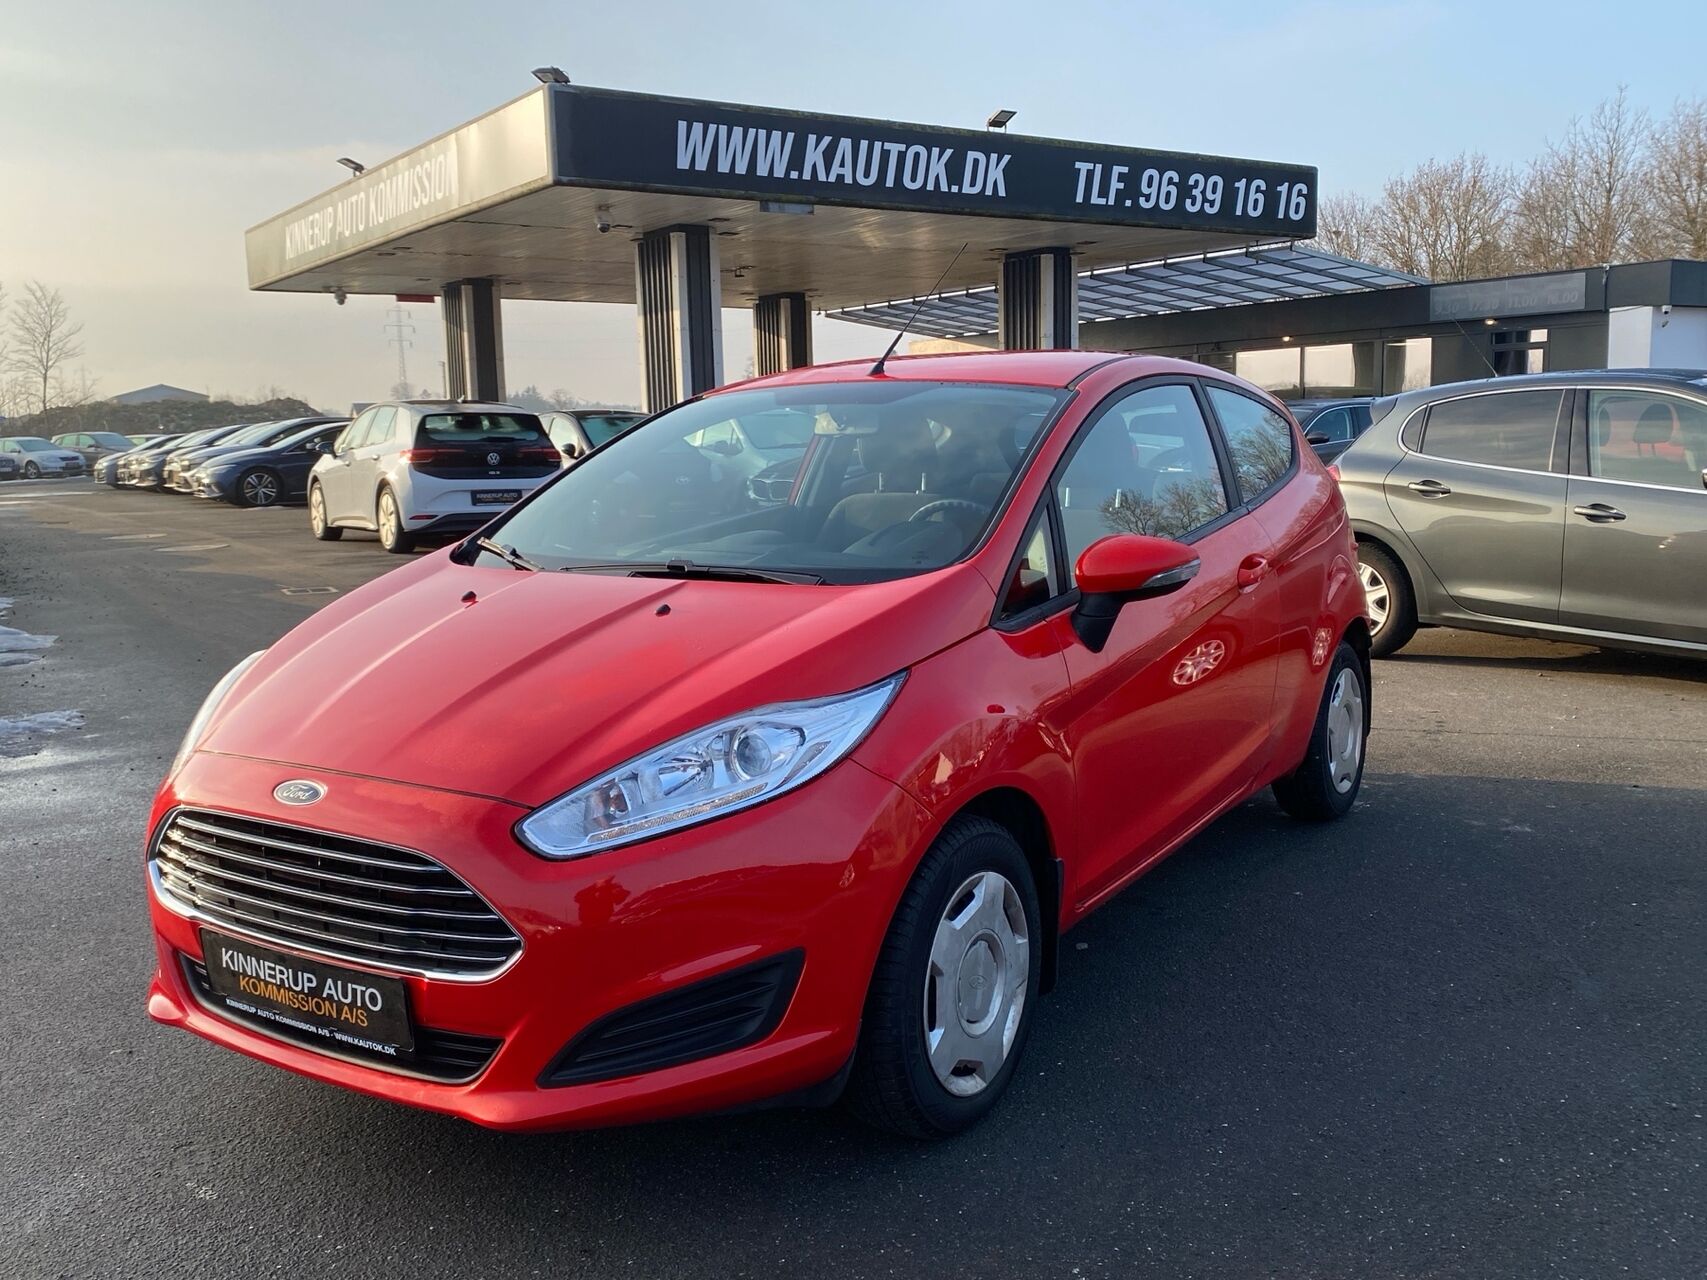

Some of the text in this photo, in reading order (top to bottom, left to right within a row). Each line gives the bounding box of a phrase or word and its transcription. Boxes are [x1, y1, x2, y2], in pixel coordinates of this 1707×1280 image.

[676, 119, 1012, 198] WWW.KAUTOK.DK
[285, 150, 456, 261] KINNERUP AUTO KOMMISSION
[1074, 161, 1308, 221] TLF. 96 39 16 16
[282, 784, 314, 800] Ford
[221, 948, 383, 1012] KINNERUP AUTO
[239, 975, 368, 1027] KOMMISSION A/S
[226, 998, 256, 1014] KINNERUP
[257, 1008, 275, 1020] AUTO
[275, 1013, 317, 1033] KOMMISSION
